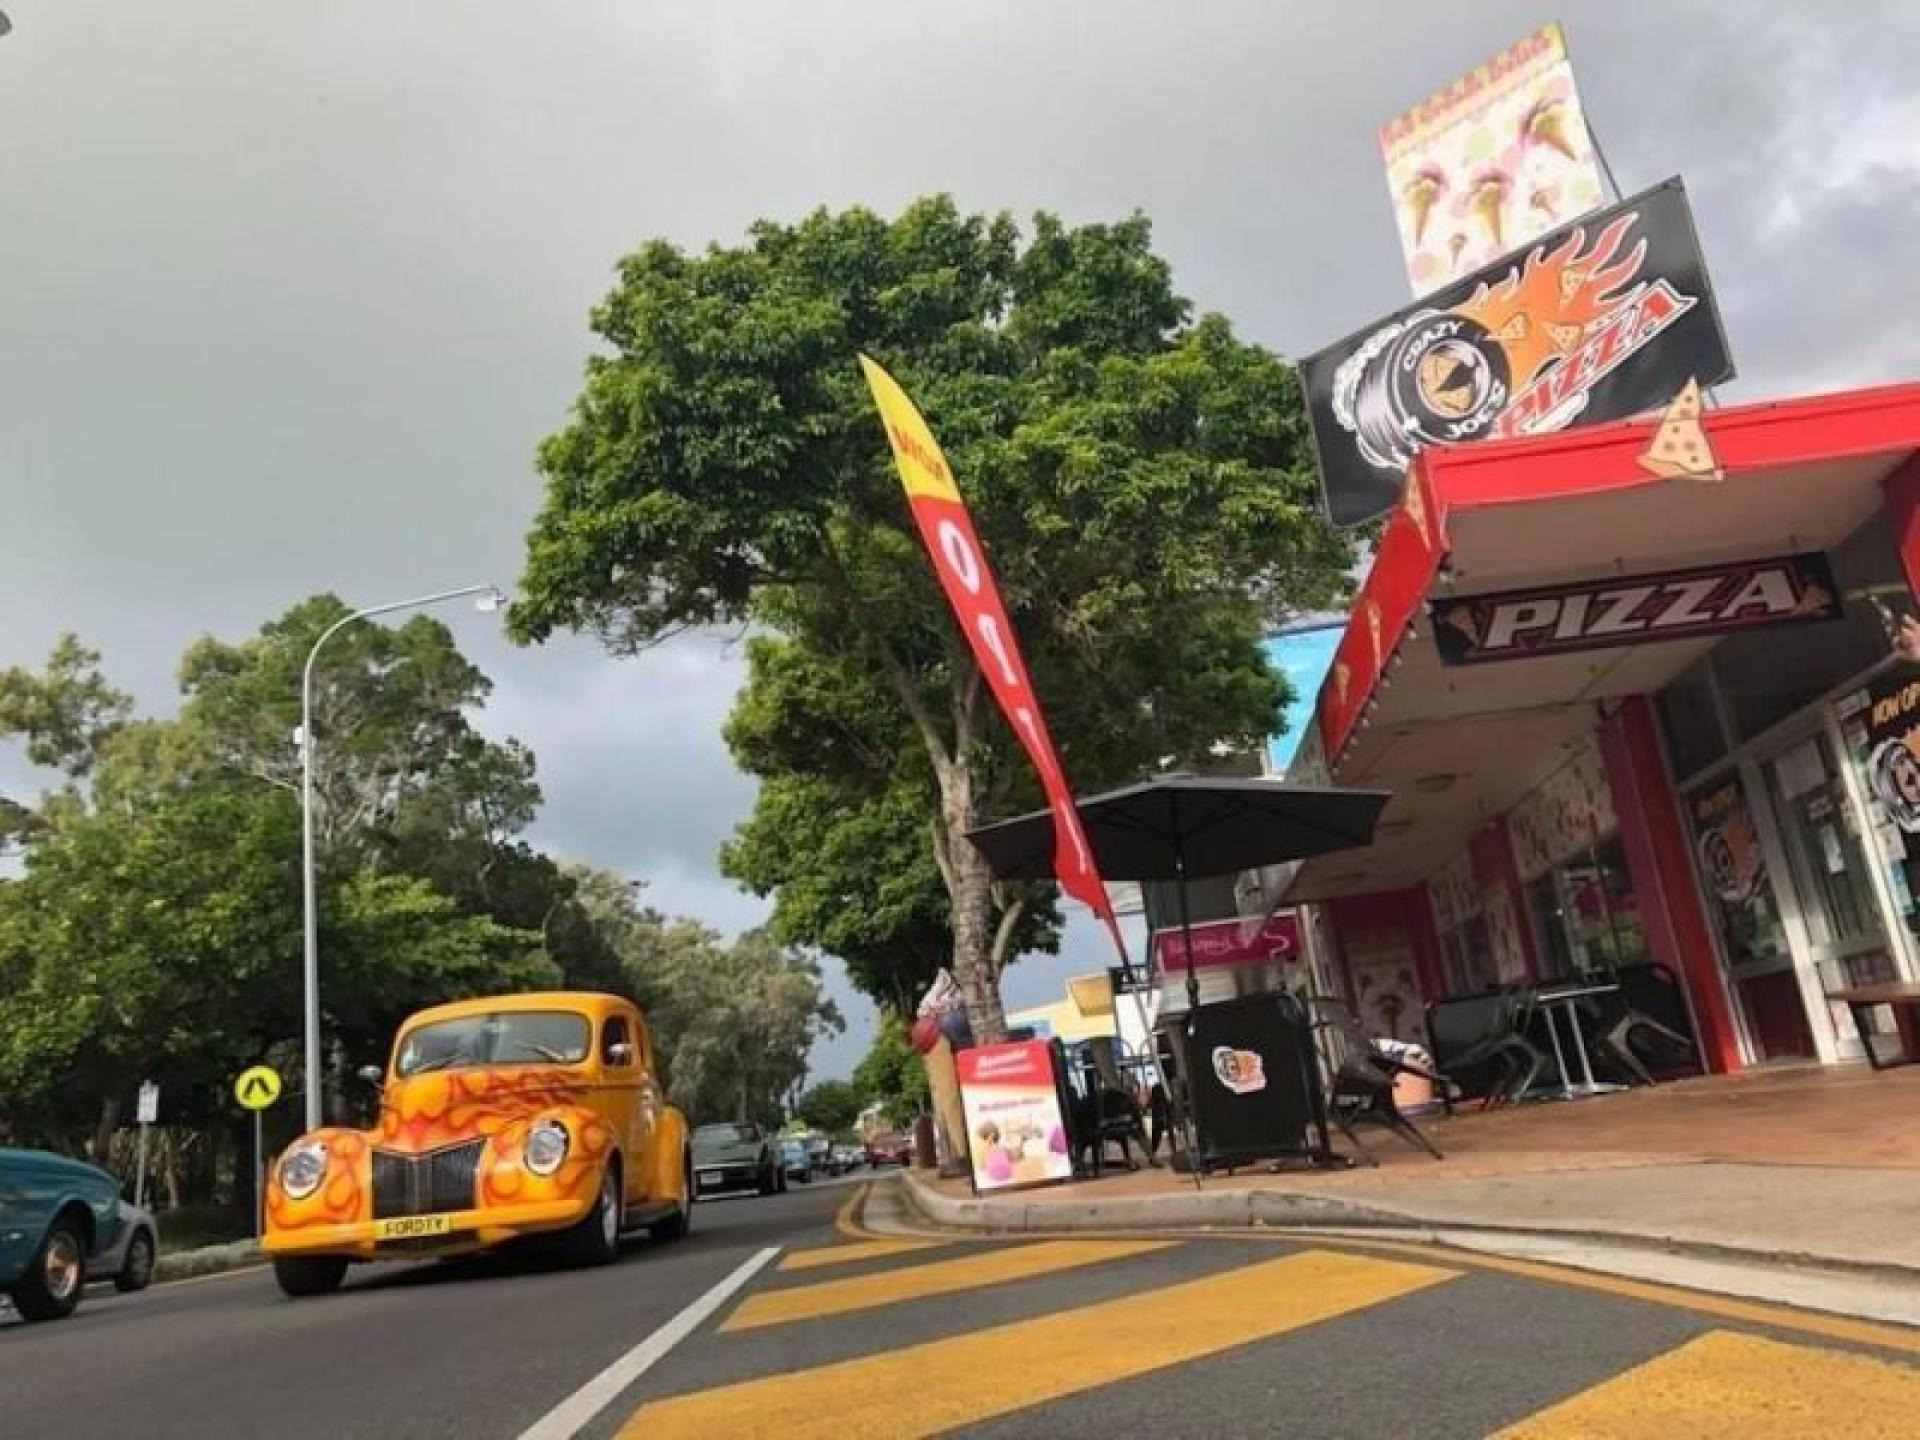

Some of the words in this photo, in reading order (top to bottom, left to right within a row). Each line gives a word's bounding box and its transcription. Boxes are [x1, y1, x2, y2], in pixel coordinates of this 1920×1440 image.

[1402, 319, 1464, 372] CRAZY
[1496, 282, 1692, 437] PIZZA
[1484, 568, 1799, 649] PIZZA
